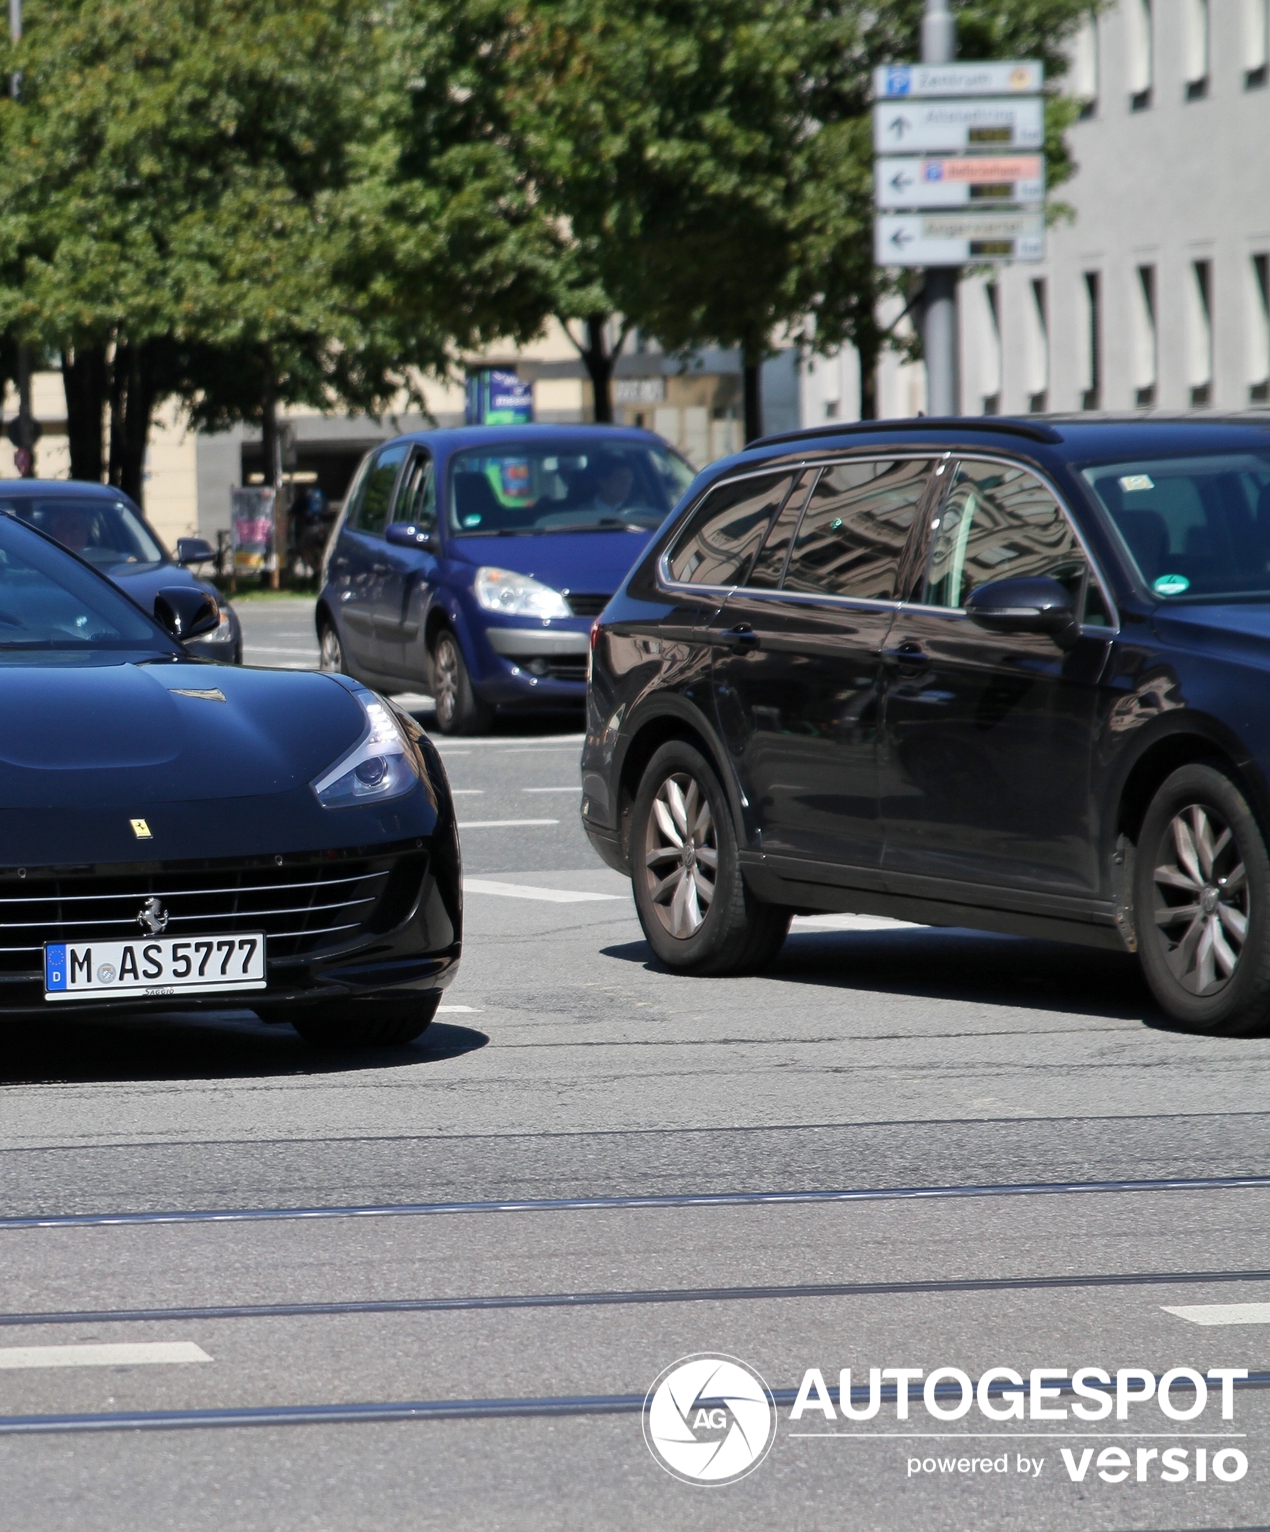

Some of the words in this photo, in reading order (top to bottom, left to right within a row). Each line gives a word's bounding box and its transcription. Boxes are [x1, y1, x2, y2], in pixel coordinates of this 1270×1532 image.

[920, 71, 991, 88] Zentrum
[52, 971, 61, 983] D
[70, 948, 92, 983] M
[118, 943, 163, 981] AS
[172, 938, 258, 979] 5777
